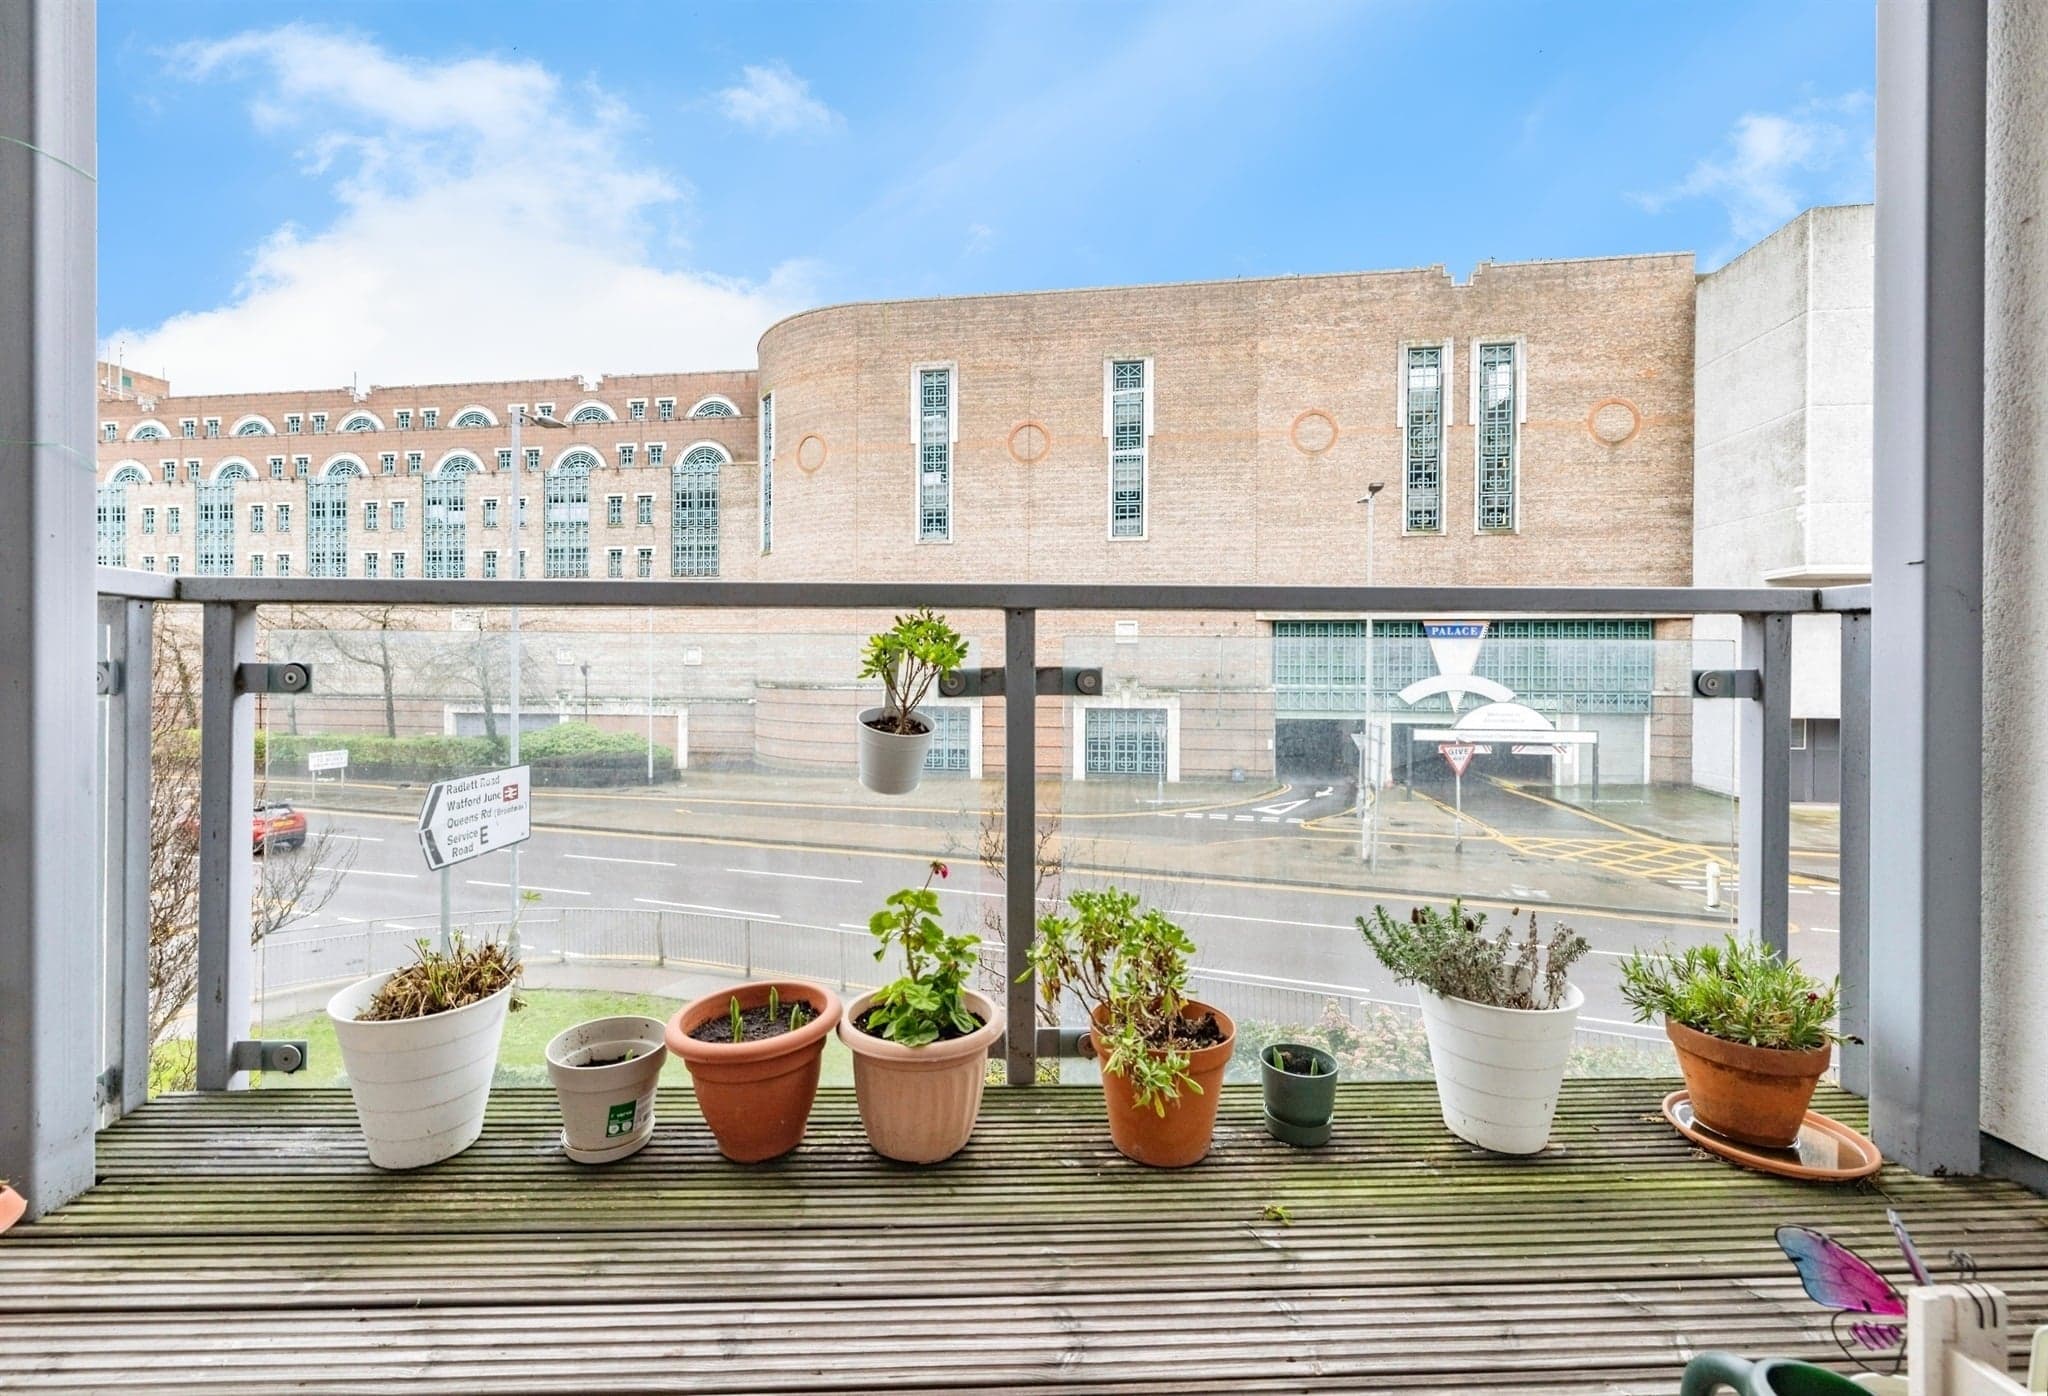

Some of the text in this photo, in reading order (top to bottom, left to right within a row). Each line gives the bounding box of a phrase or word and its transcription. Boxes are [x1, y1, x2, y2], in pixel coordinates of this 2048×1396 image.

[1432, 626, 1478, 636] PALACE
[447, 792, 502, 811] Watford Junc
[447, 813, 479, 829] Queens
[481, 809, 492, 820] Rd
[447, 830, 479, 846] Service
[480, 825, 489, 845] E
[452, 844, 474, 858] Road
